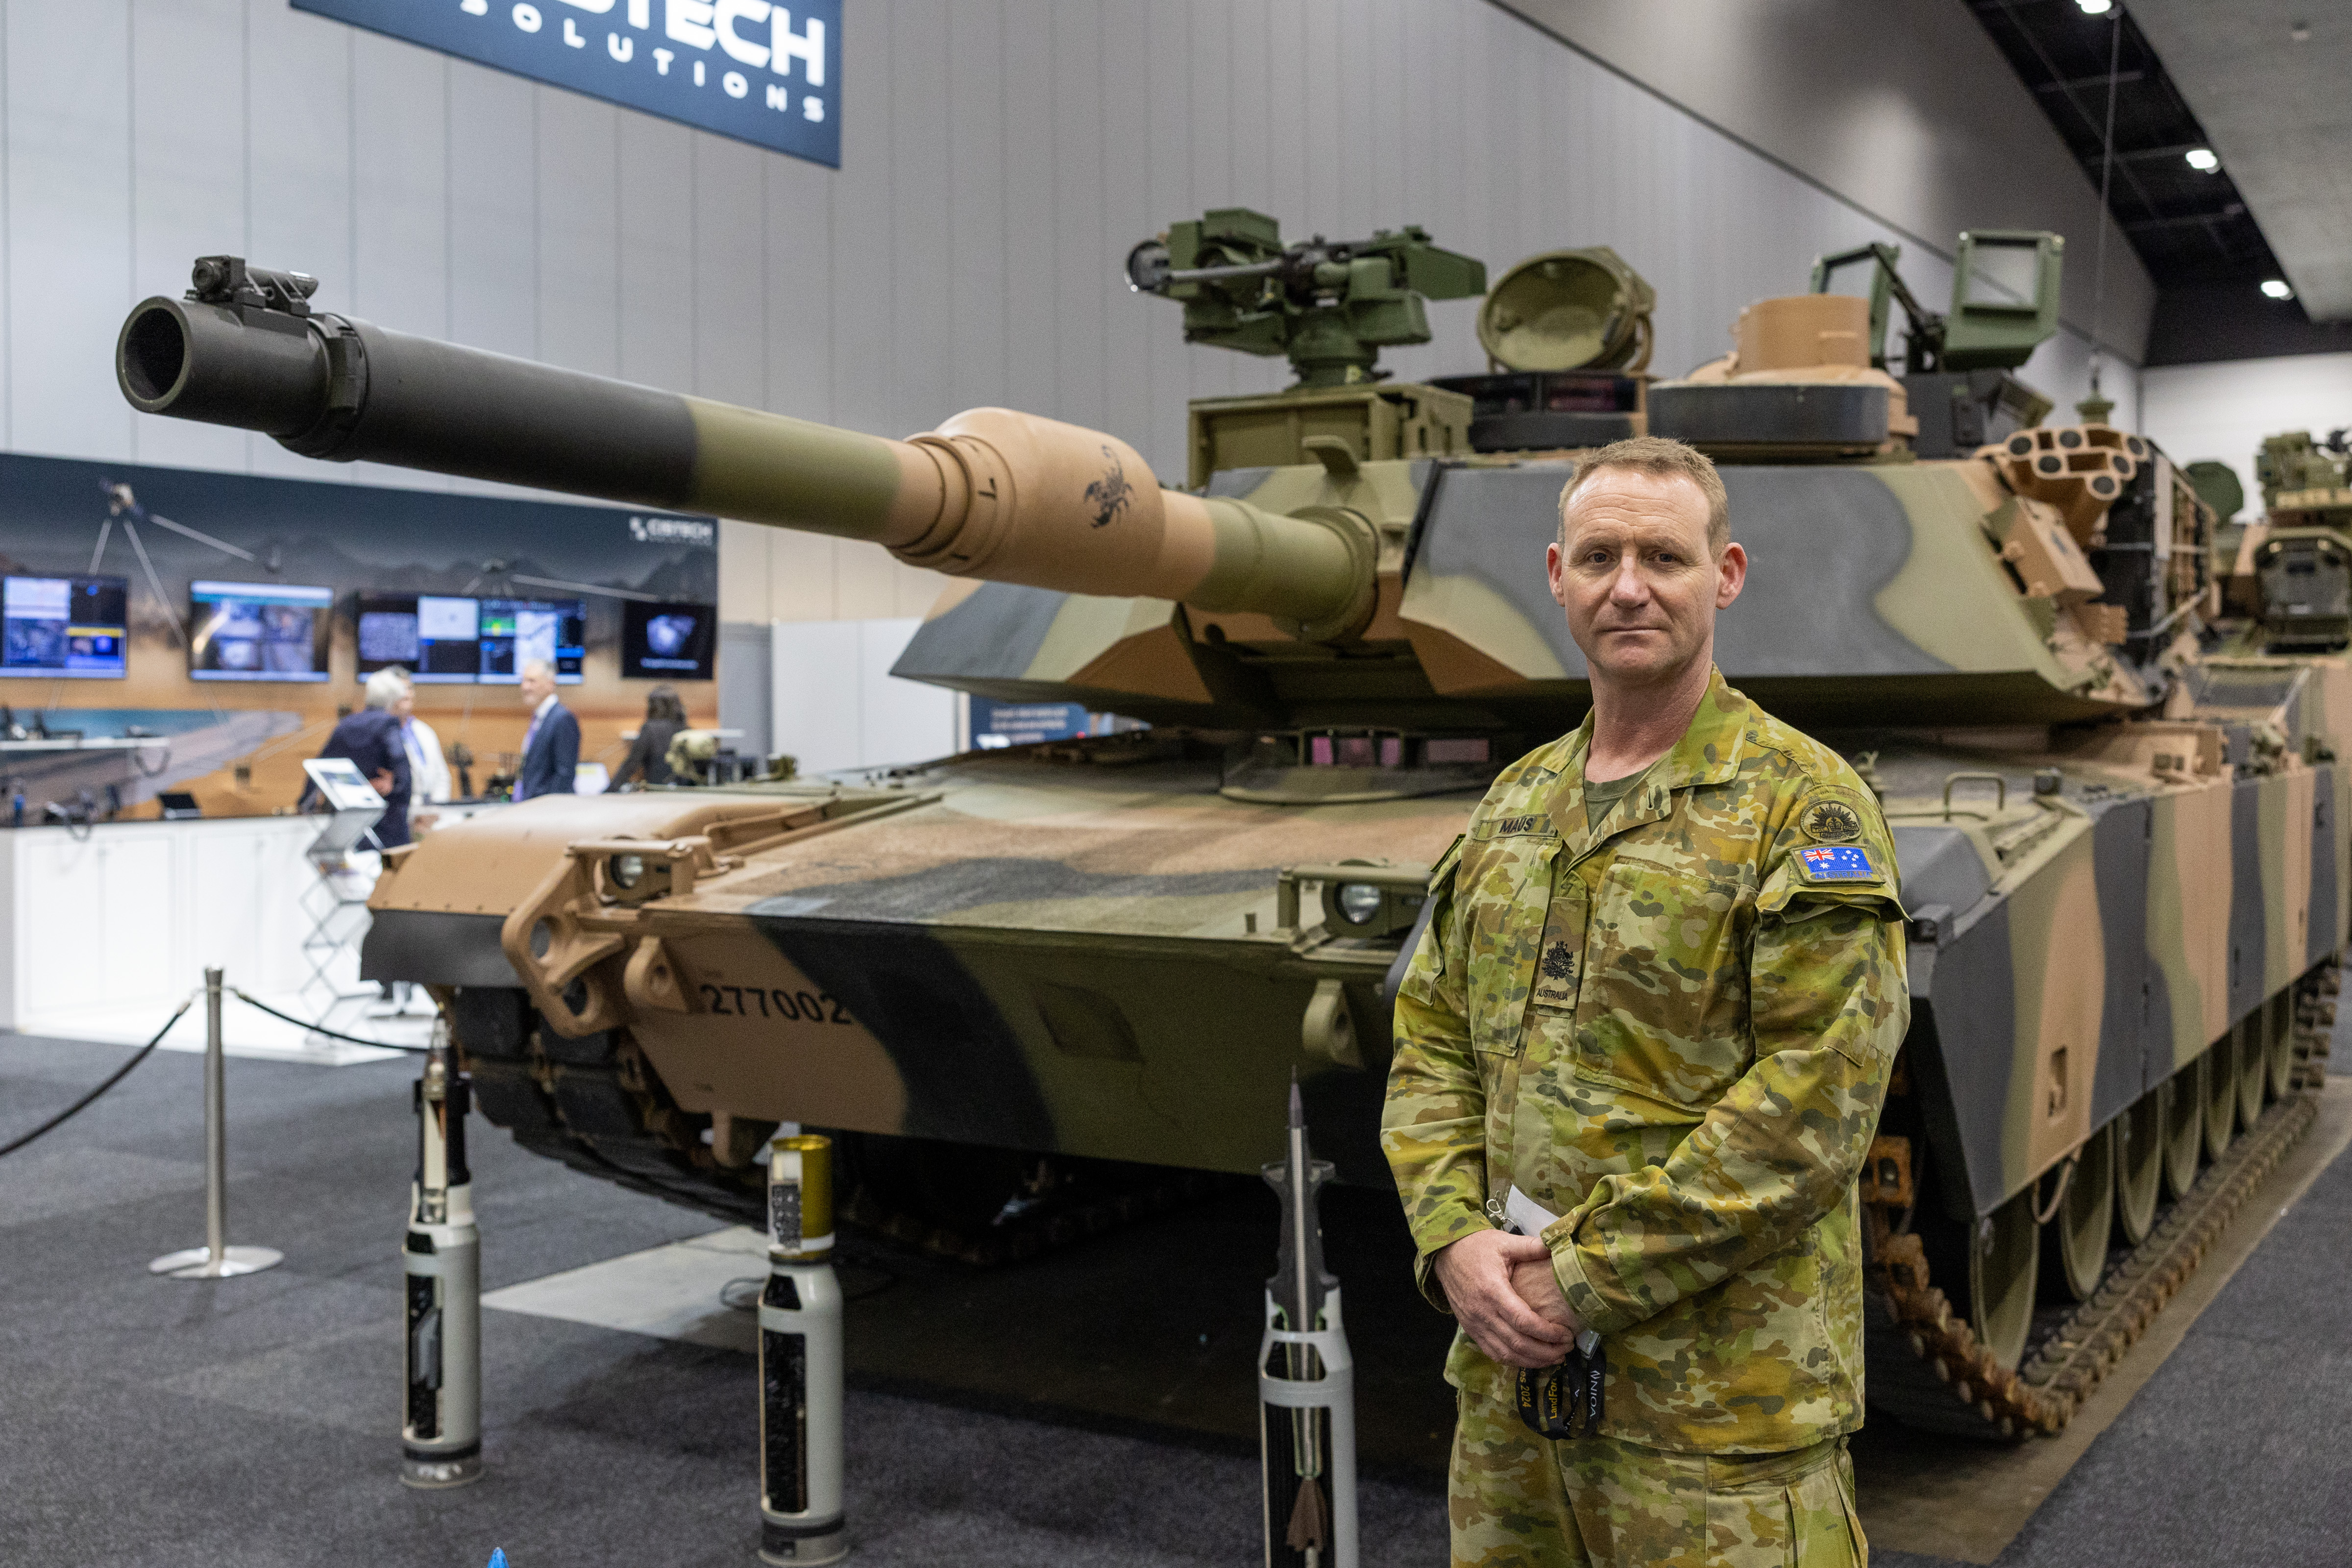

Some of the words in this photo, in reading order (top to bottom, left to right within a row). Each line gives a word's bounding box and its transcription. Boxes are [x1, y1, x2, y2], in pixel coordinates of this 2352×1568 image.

[1498, 817, 1534, 833] MAUS
[1815, 871, 1872, 879] AUSTRALIA
[1536, 988, 1568, 1001] AUSTRALIA
[700, 984, 853, 1025] 277002
[1520, 1385, 1532, 1408] 2024
